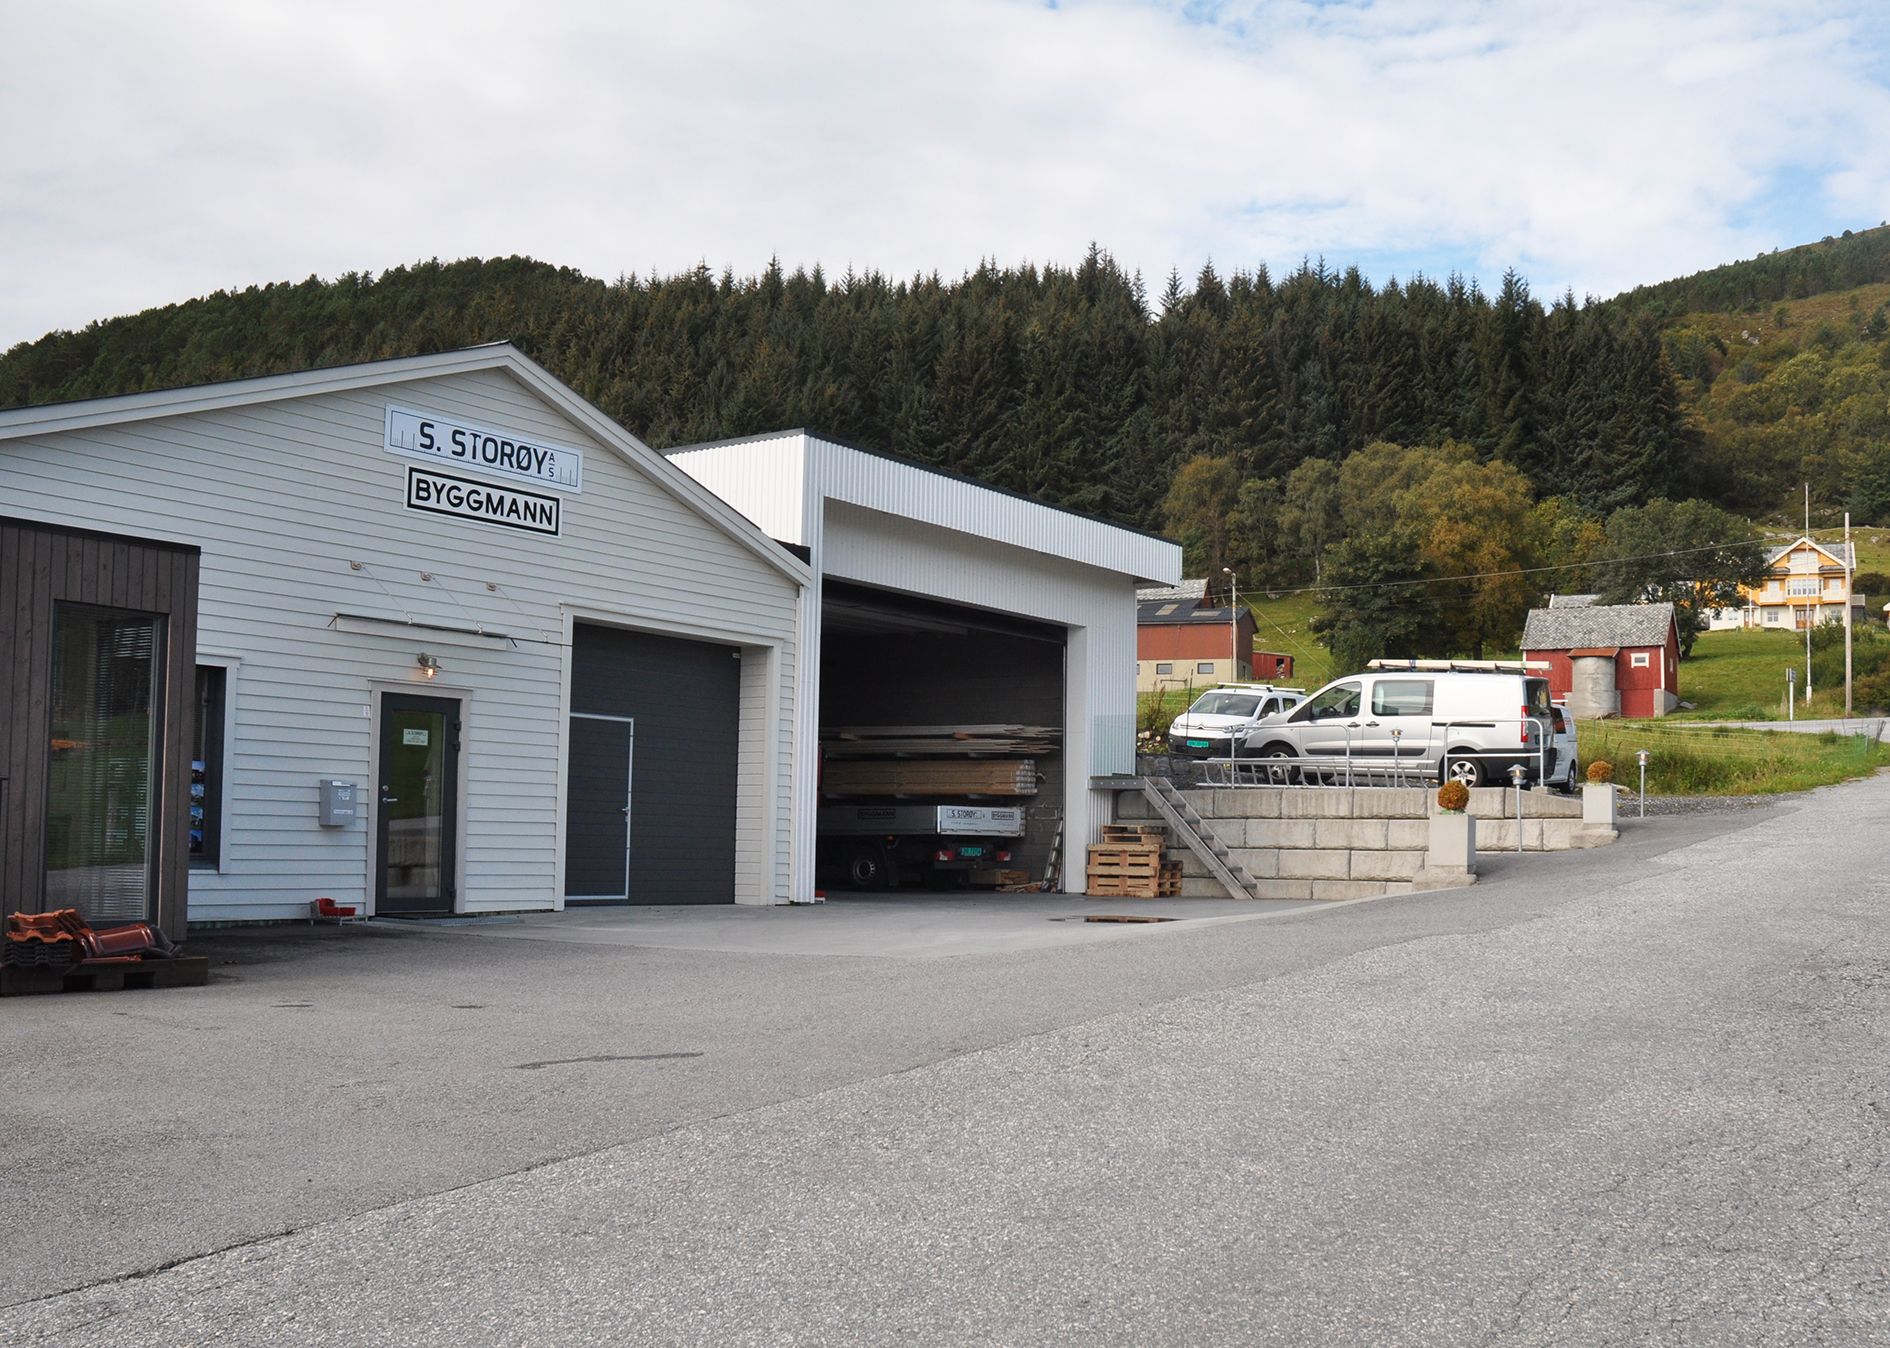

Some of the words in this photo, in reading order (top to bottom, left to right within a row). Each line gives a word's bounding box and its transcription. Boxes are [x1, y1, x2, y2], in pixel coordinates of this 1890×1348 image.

[419, 422, 441, 452] S.
[451, 429, 548, 475] STORØY
[415, 477, 553, 526] BYGGMANN
